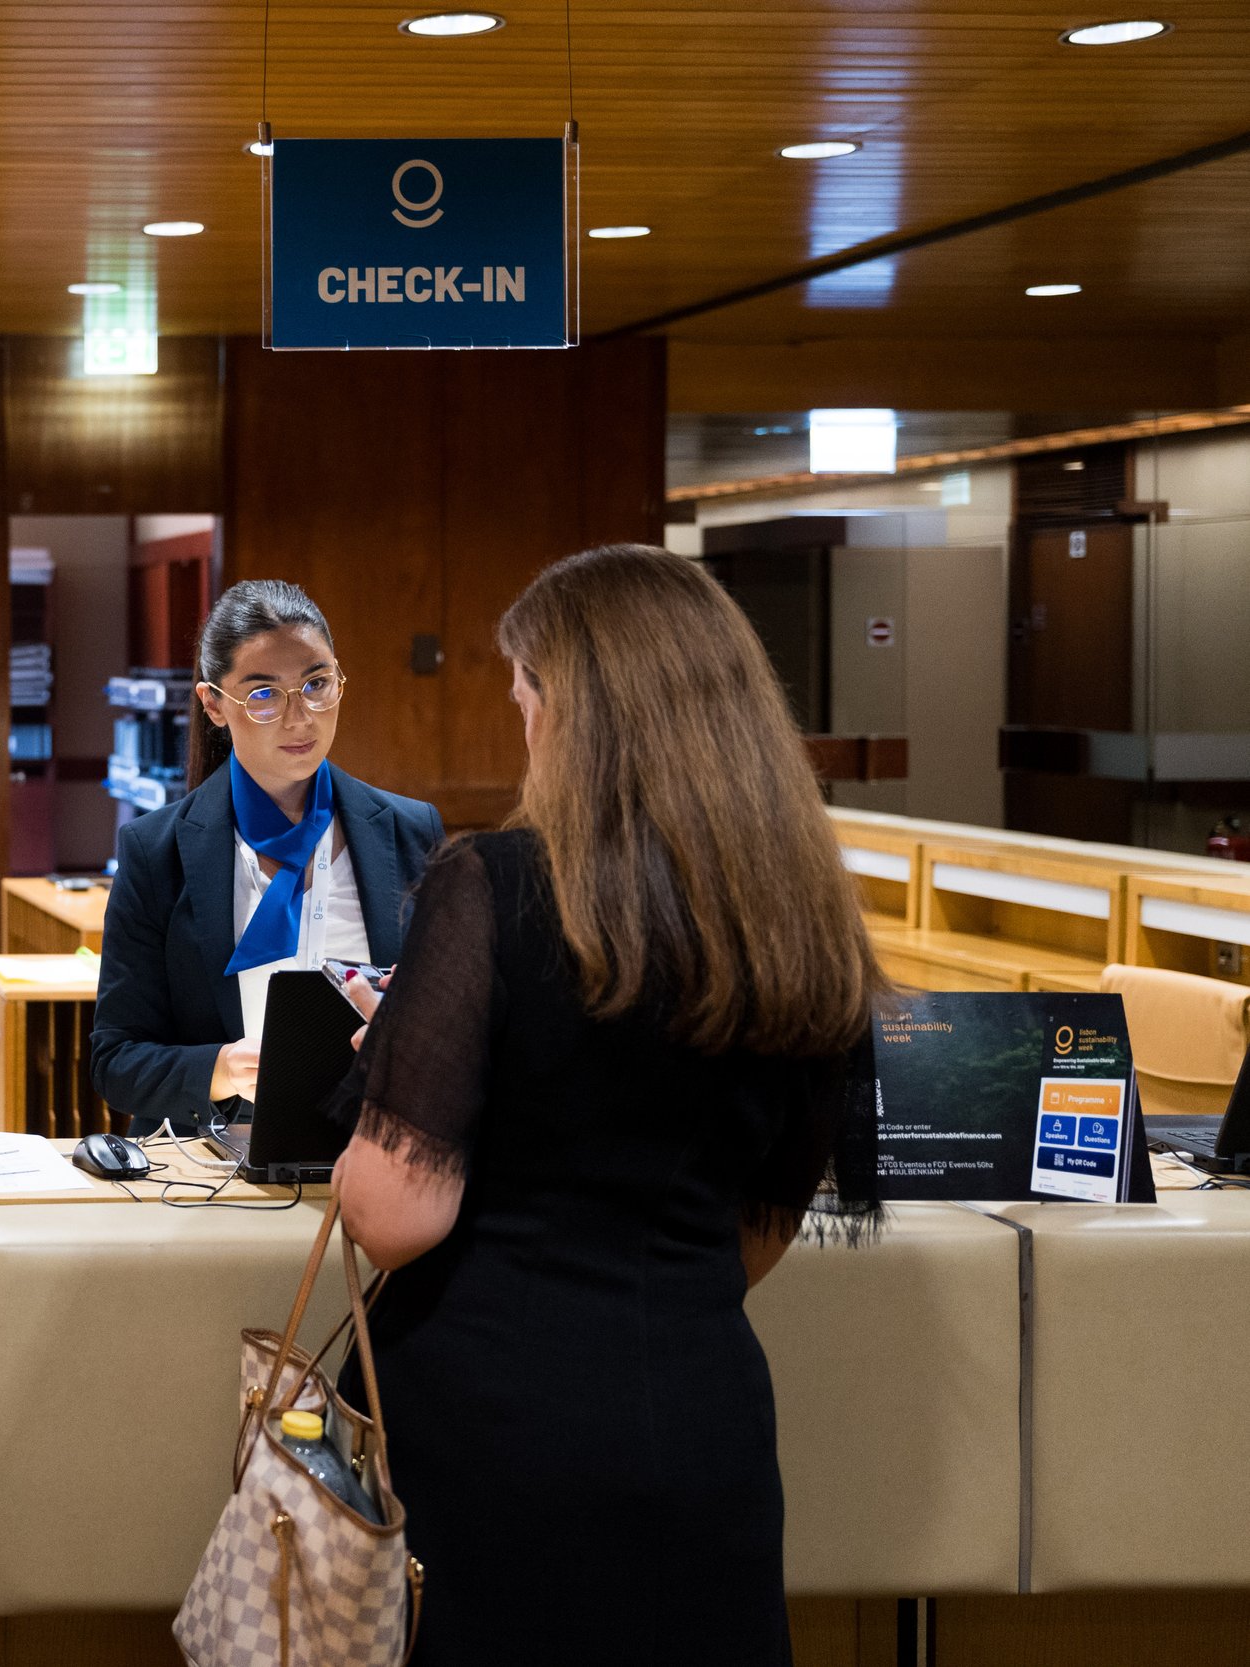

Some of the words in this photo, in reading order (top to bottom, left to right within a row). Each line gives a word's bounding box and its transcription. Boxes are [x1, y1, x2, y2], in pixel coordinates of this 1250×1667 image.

[317, 266, 526, 303] CHECK-IN
[881, 1021, 953, 1033] sustainability
[883, 1034, 912, 1042] week
[886, 1123, 904, 1131] Code
[1045, 1132, 1068, 1140] Speakers
[1084, 1135, 1111, 1144] Questions
[1067, 1158, 1075, 1166] My
[1083, 1160, 1097, 1168] Code
